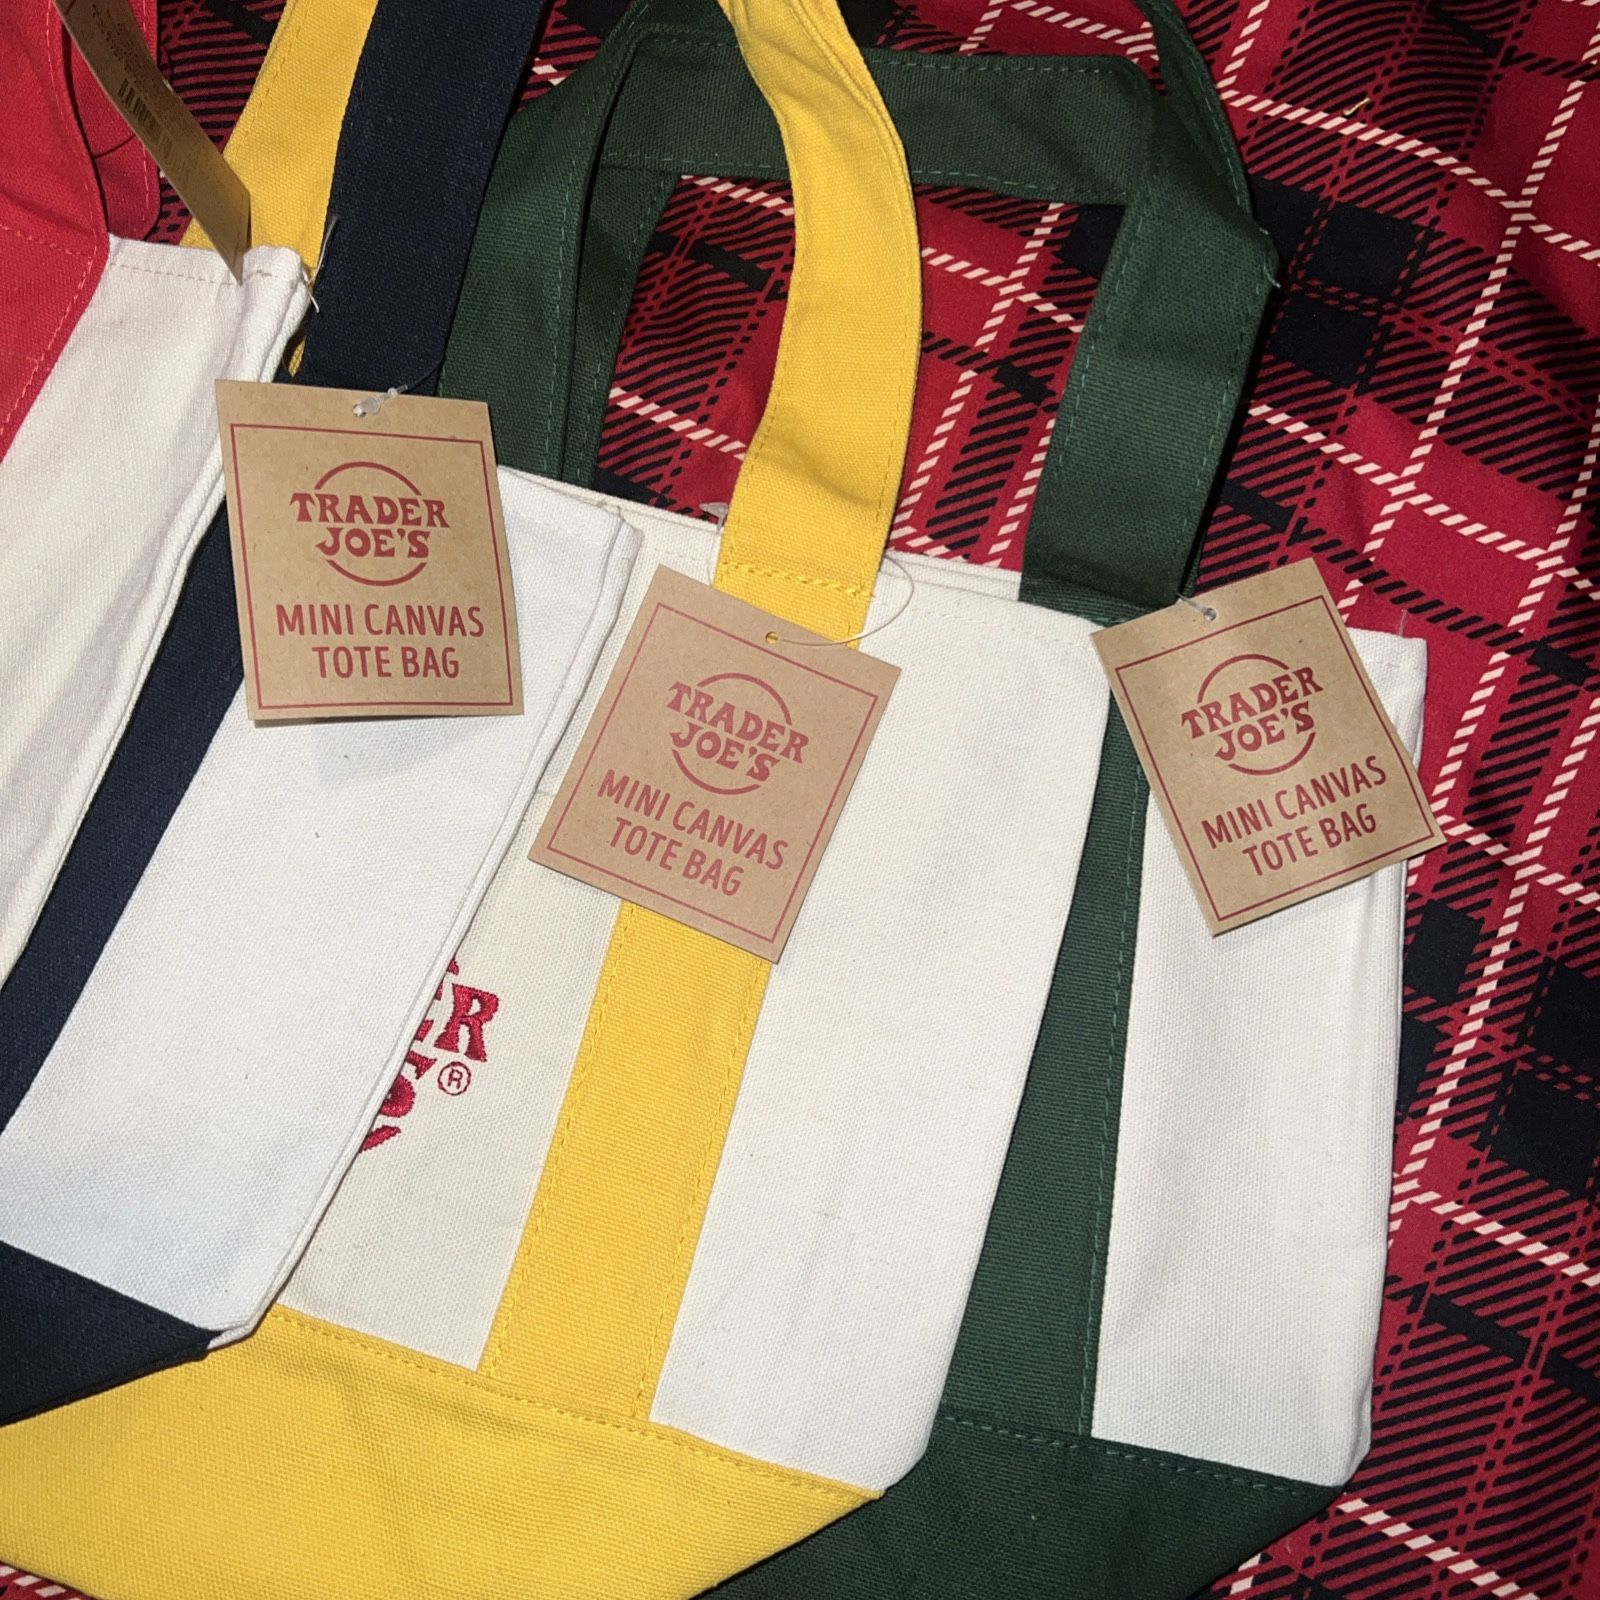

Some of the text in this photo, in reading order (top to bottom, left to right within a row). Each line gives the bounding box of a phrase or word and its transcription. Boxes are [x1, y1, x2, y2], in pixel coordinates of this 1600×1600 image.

[289, 493, 450, 528] TRADER
[315, 527, 430, 559] JOE'S
[275, 604, 484, 638] MINI CANVAS
[312, 646, 460, 679] TOTE BAG
[666, 681, 810, 764] TRADER
[1181, 666, 1324, 740] TRADER
[1215, 701, 1315, 761] JOE'S
[669, 721, 780, 783] JOE'S
[597, 769, 789, 871] MINI CANVAS
[1201, 755, 1387, 849] MINI CANVAS
[610, 817, 745, 897] TOTE BAG
[1242, 803, 1377, 876] TOTE BAG
